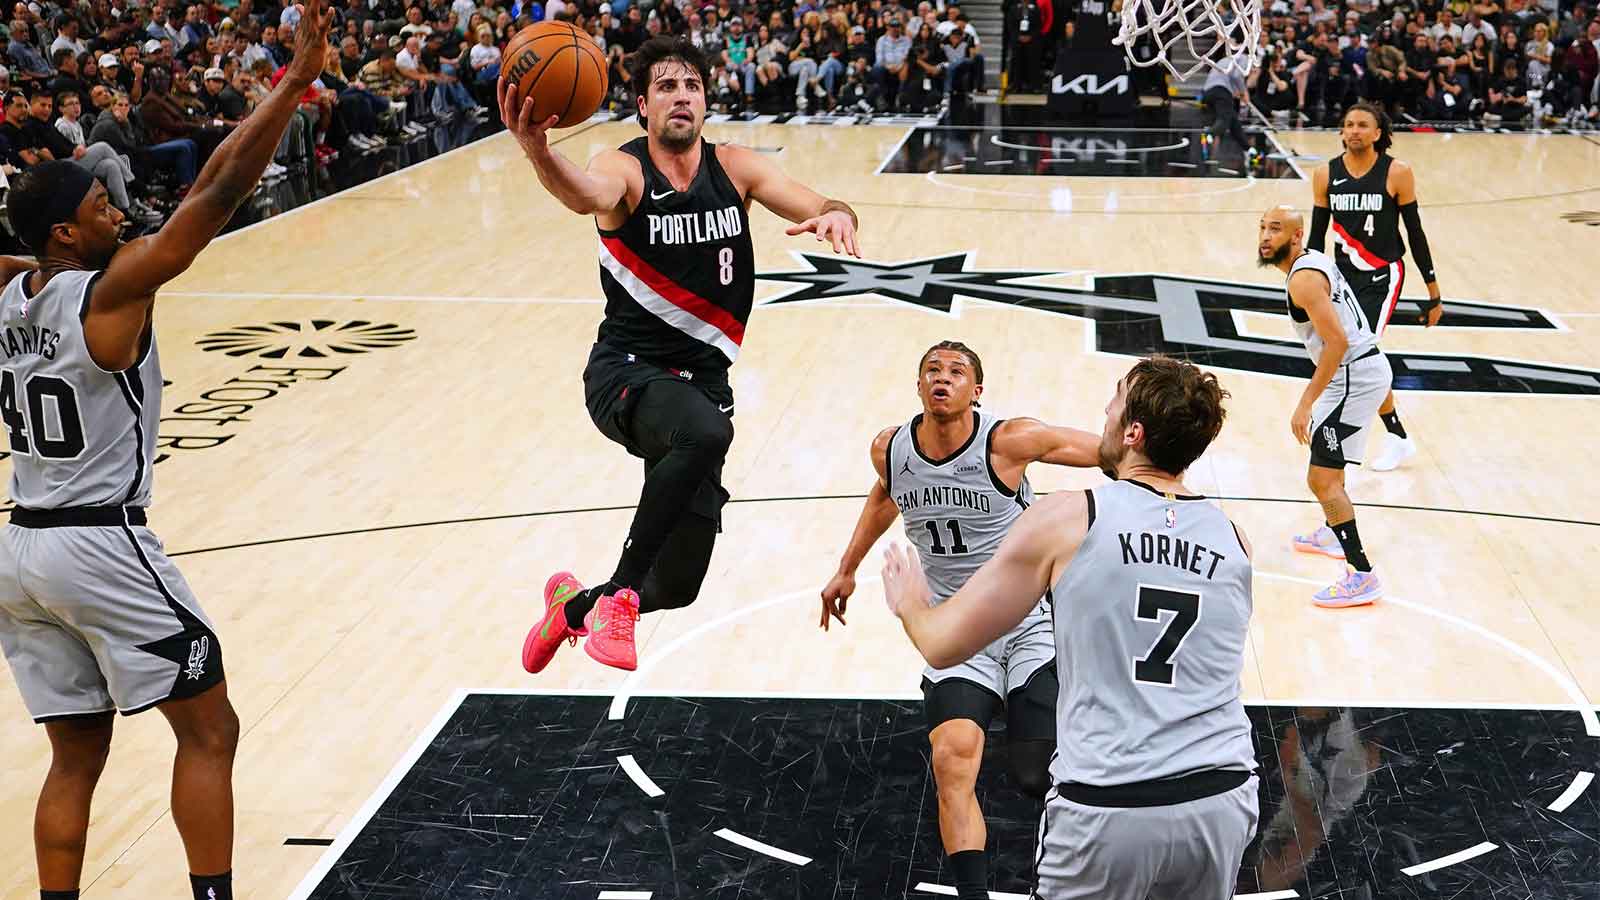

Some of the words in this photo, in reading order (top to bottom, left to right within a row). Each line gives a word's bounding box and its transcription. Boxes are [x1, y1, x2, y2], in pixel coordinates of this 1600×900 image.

[1051, 74, 1129, 95] KIA
[1330, 193, 1383, 212] PORTLAND
[648, 205, 742, 246] PORTLAND
[1363, 214, 1375, 237] 4
[718, 247, 734, 286] 8
[0, 367, 88, 461] 40
[897, 491, 919, 514] SAN
[923, 486, 990, 514] ANTONIO
[925, 519, 969, 555] 11
[1117, 532, 1225, 581] KORNET
[1133, 584, 1201, 687] 7
